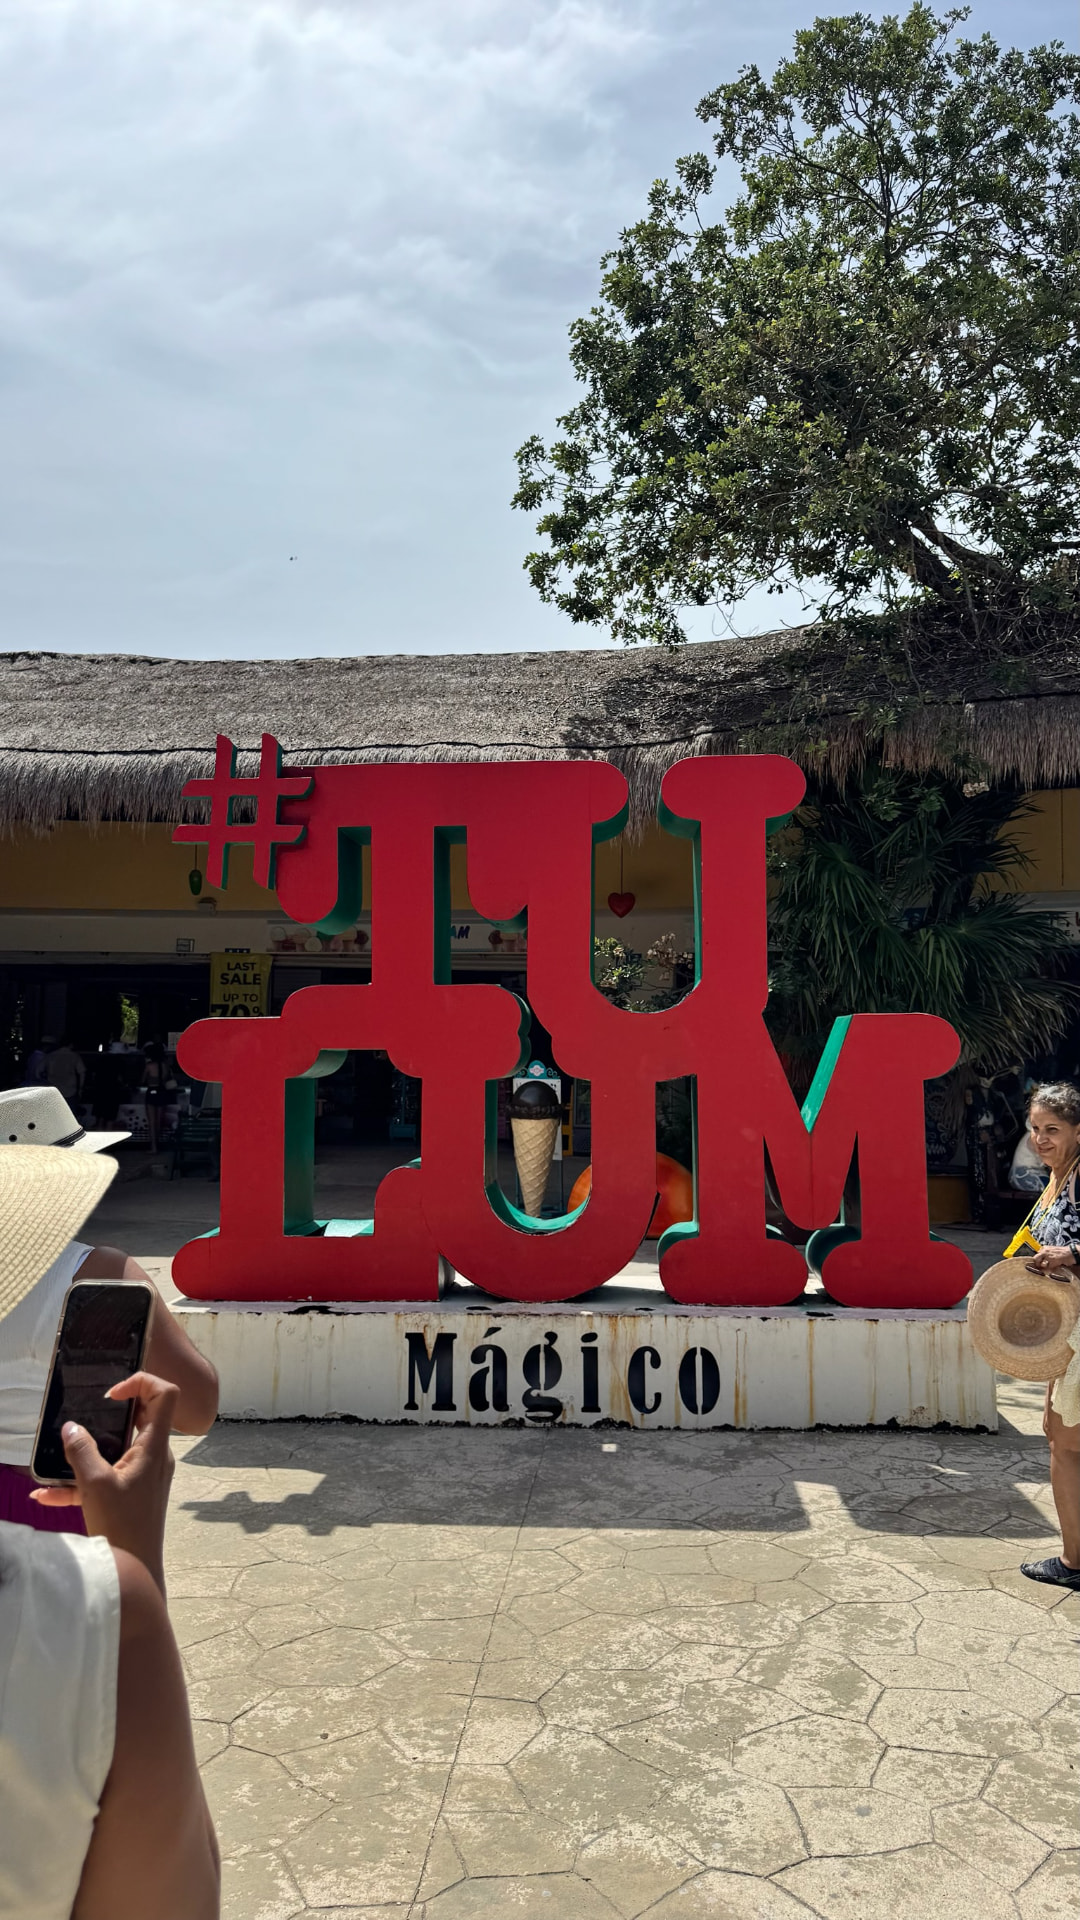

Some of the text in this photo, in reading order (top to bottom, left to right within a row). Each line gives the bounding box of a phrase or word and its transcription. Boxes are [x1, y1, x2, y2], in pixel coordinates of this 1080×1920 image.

[227, 962, 256, 971] LAST
[220, 973, 261, 985] SALE
[223, 993, 258, 1002] UP TO
[404, 1326, 721, 1424] Mágico
